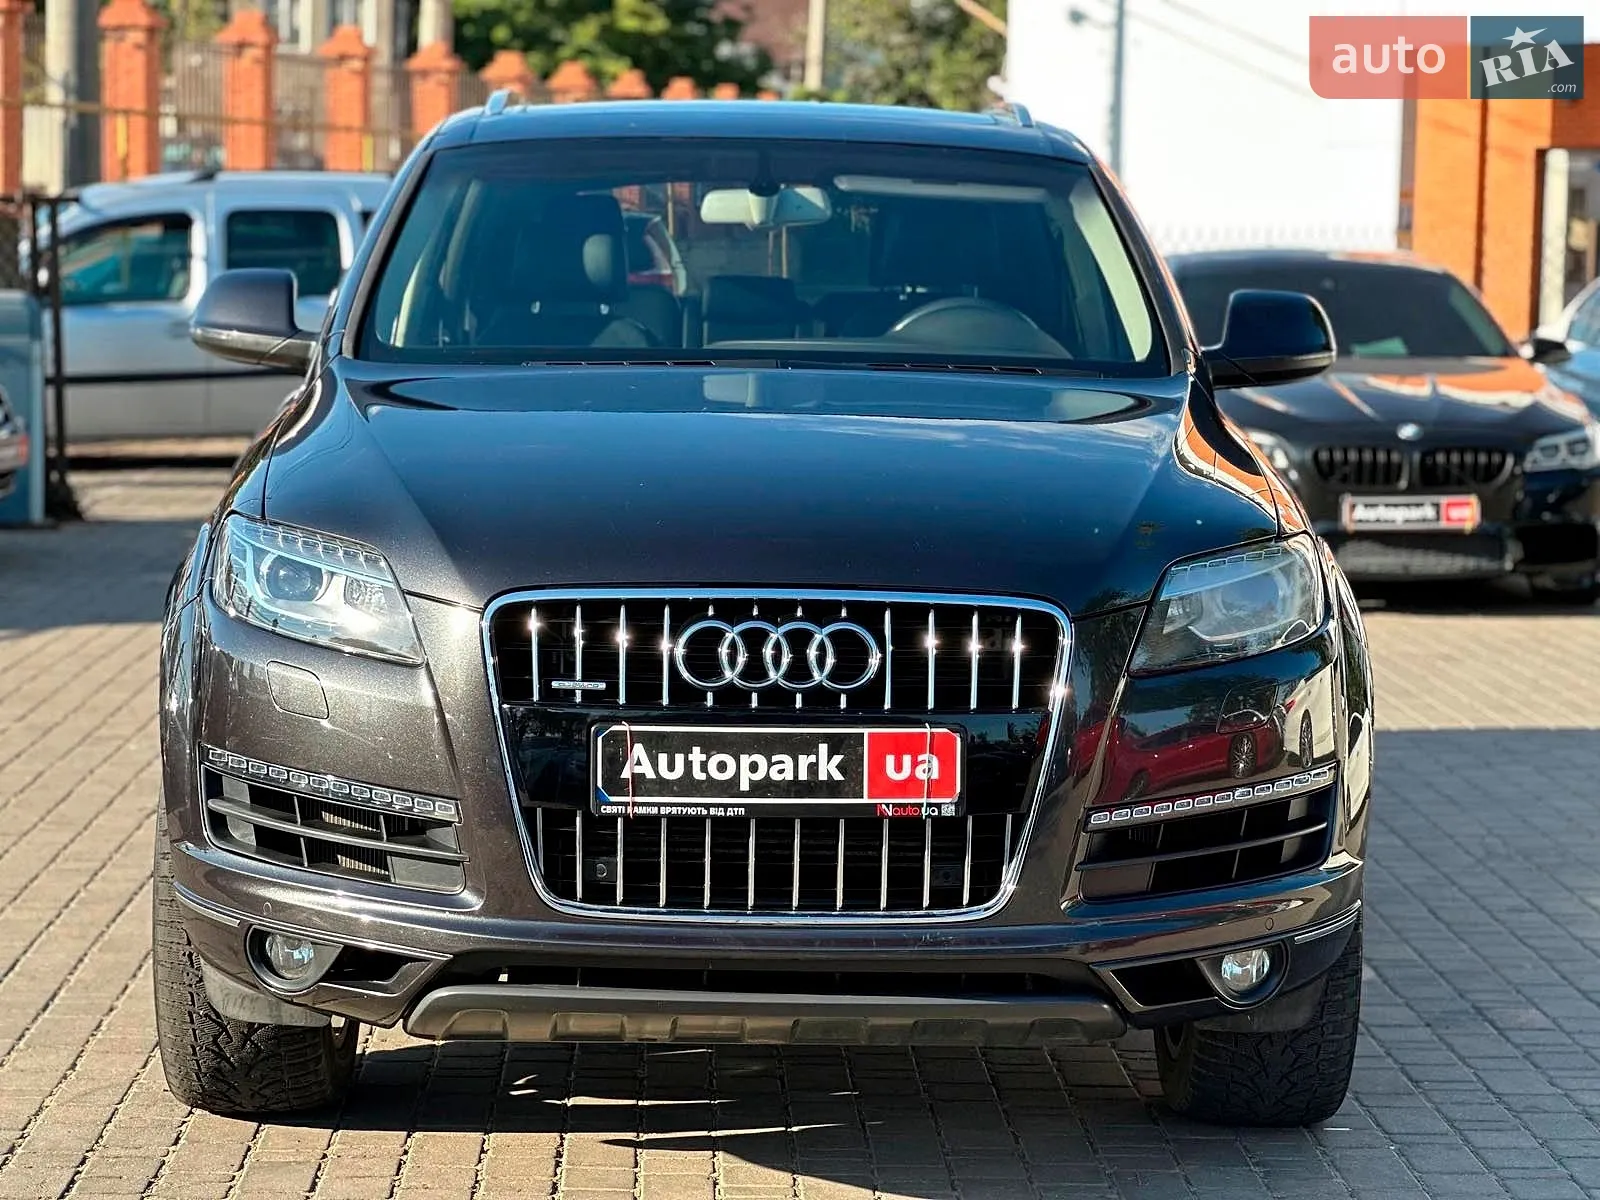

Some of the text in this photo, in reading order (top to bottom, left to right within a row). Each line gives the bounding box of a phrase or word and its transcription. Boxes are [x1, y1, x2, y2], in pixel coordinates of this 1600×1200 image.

[620, 743, 940, 791] Autopark ua
[660, 806, 708, 815] ВРЯТУЮТЬ
[709, 806, 725, 816] ВІД
[726, 807, 745, 815] ДТП
